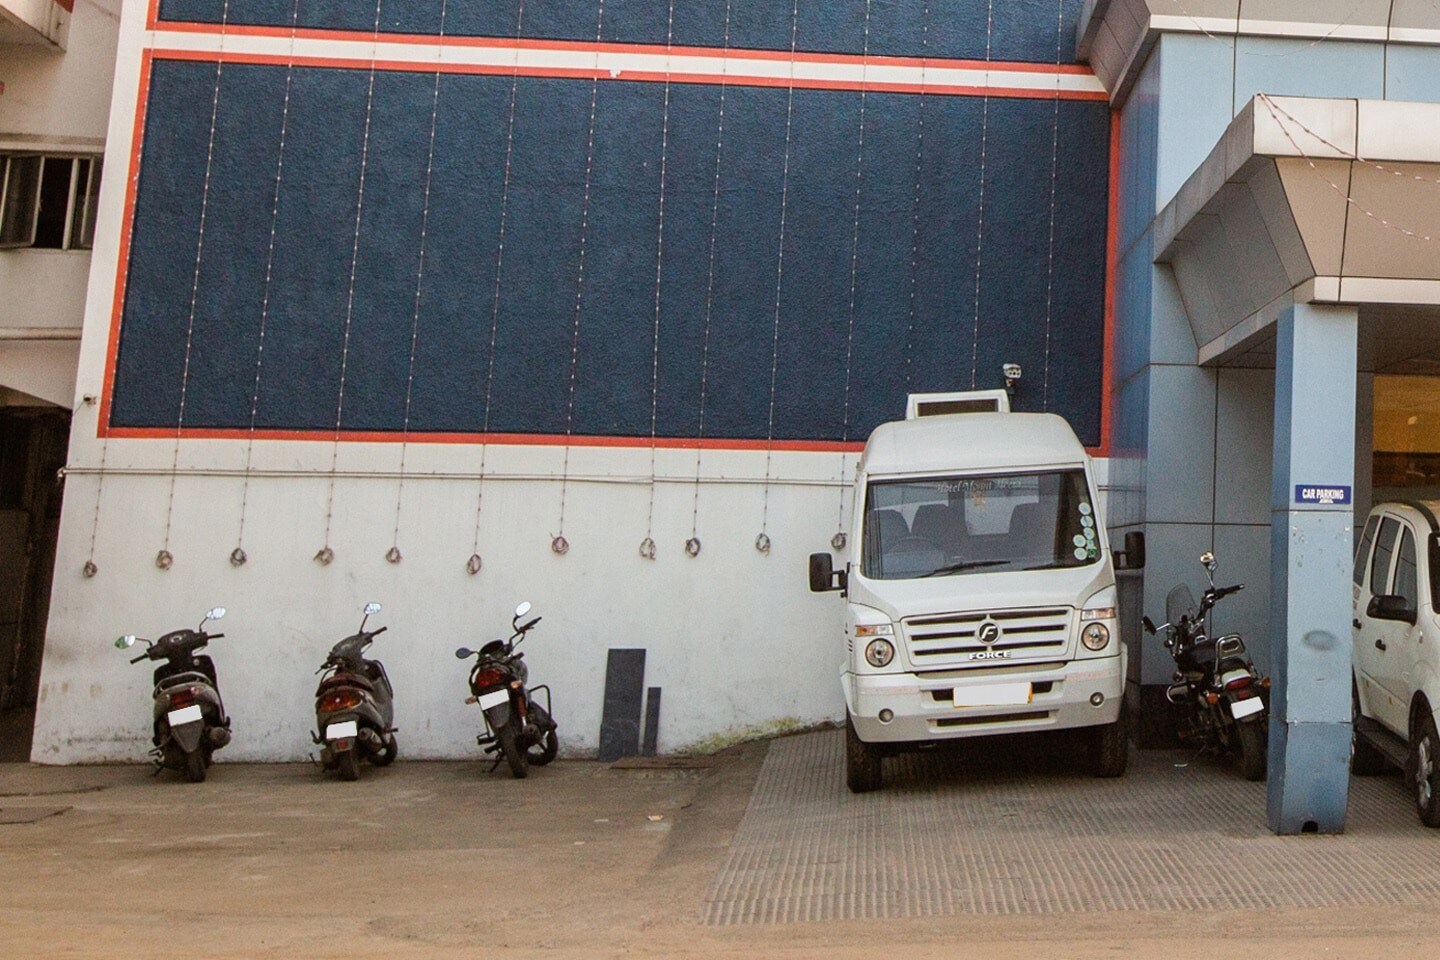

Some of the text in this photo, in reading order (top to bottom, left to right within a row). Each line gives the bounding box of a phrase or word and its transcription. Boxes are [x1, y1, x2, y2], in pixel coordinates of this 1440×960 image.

[1302, 488, 1344, 500] CAR PARKING
[969, 651, 1011, 660] FORCE
